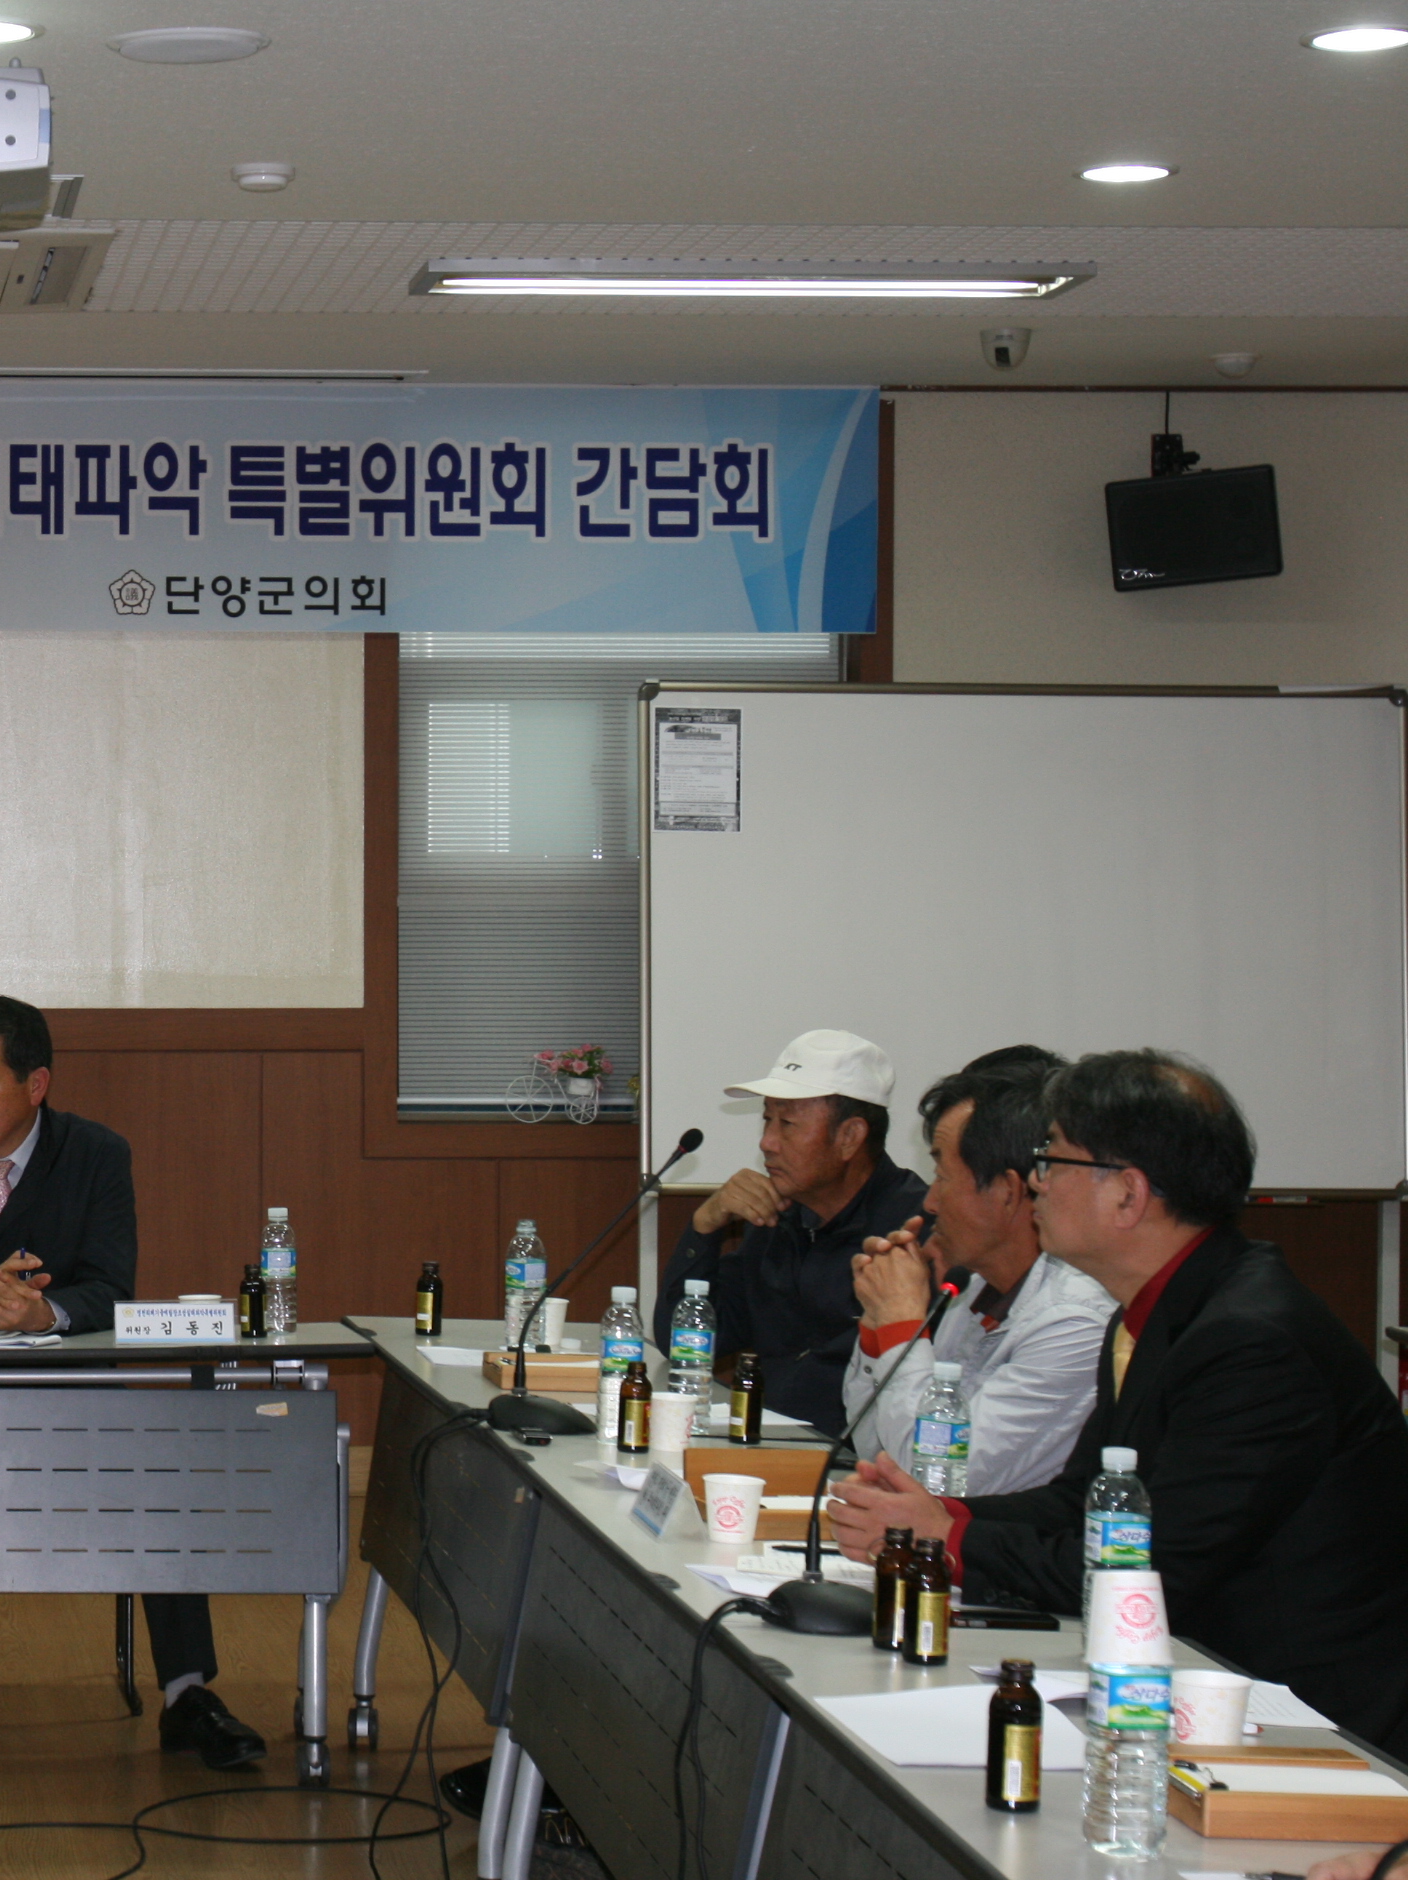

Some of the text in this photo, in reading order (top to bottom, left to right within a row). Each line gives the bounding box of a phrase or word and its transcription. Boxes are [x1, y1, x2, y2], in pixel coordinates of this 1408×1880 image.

[228, 442, 546, 538] 특별위원회
[576, 443, 769, 538] 간담회
[165, 574, 387, 618] 단양군의회
